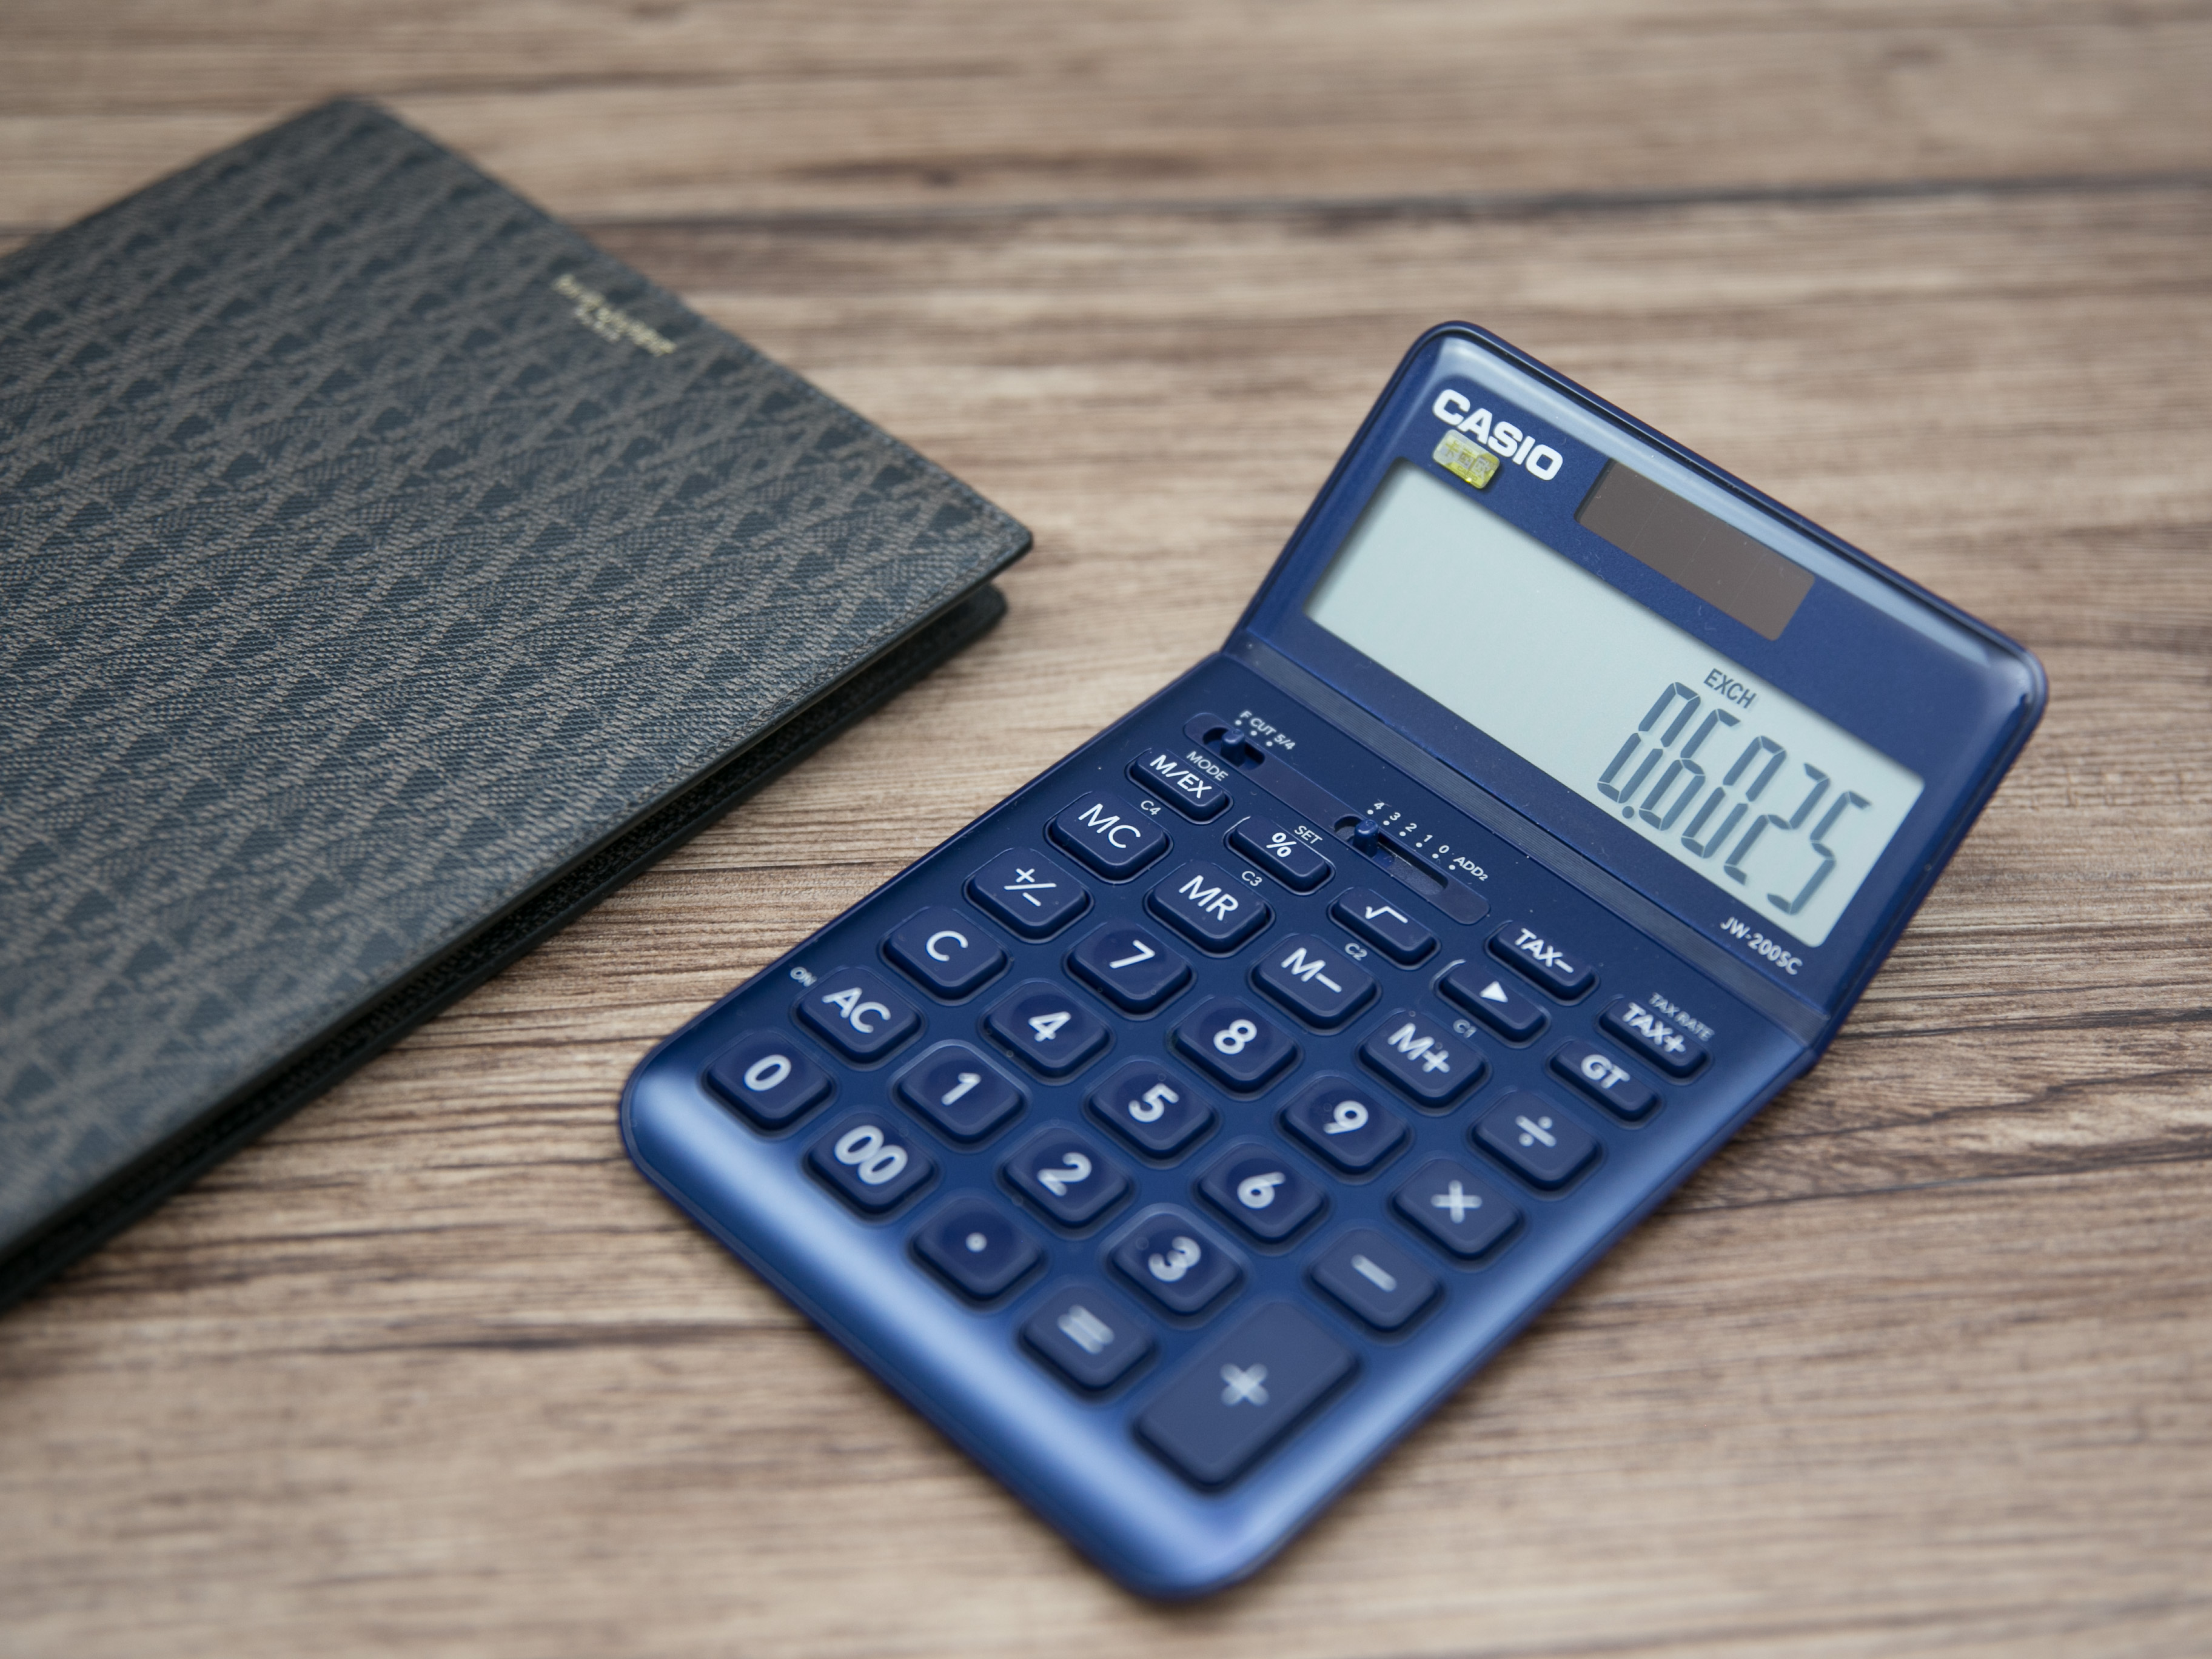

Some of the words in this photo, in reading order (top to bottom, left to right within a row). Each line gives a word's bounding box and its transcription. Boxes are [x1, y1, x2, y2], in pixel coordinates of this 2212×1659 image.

[1432, 389, 1563, 481] CASIO
[1456, 464, 1479, 482] CASIO
[1703, 668, 1757, 709] EXCH
[1240, 710, 1253, 720] F
[1251, 717, 1275, 736] CUT
[1275, 732, 1296, 751] 5/4
[1149, 754, 1213, 799] M/EX
[1186, 751, 1229, 782] MODE
[1141, 800, 1161, 816] C4
[1597, 682, 1872, 916] 0.6025
[1078, 803, 1142, 849] MC
[1294, 825, 1322, 845] SET
[1373, 802, 1385, 810] 4
[1390, 812, 1401, 821] 3
[1406, 823, 1417, 832] 2
[1423, 834, 1433, 842] 1
[1439, 845, 1450, 854] 0
[1241, 871, 1262, 886] C3
[1178, 875, 1239, 921] MR
[926, 930, 968, 961] C
[1109, 939, 1155, 968] 7
[1344, 942, 1368, 960] C2
[1719, 917, 1802, 975] JW-200SC
[822, 987, 891, 1033] AC
[1028, 1011, 1071, 1042] 4
[1649, 992, 1679, 1018] TAX
[1674, 1011, 1715, 1041] RATE
[1213, 1019, 1257, 1054] 8
[744, 1054, 791, 1091] 0
[941, 1073, 981, 1105] 1
[1581, 1054, 1630, 1089] GT
[1128, 1083, 1179, 1122] 5
[1323, 1100, 1369, 1134] 9
[834, 1125, 908, 1185] 00
[1037, 1152, 1091, 1197] 2
[1237, 1171, 1285, 1209] 6
[1148, 1236, 1201, 1282] 3
